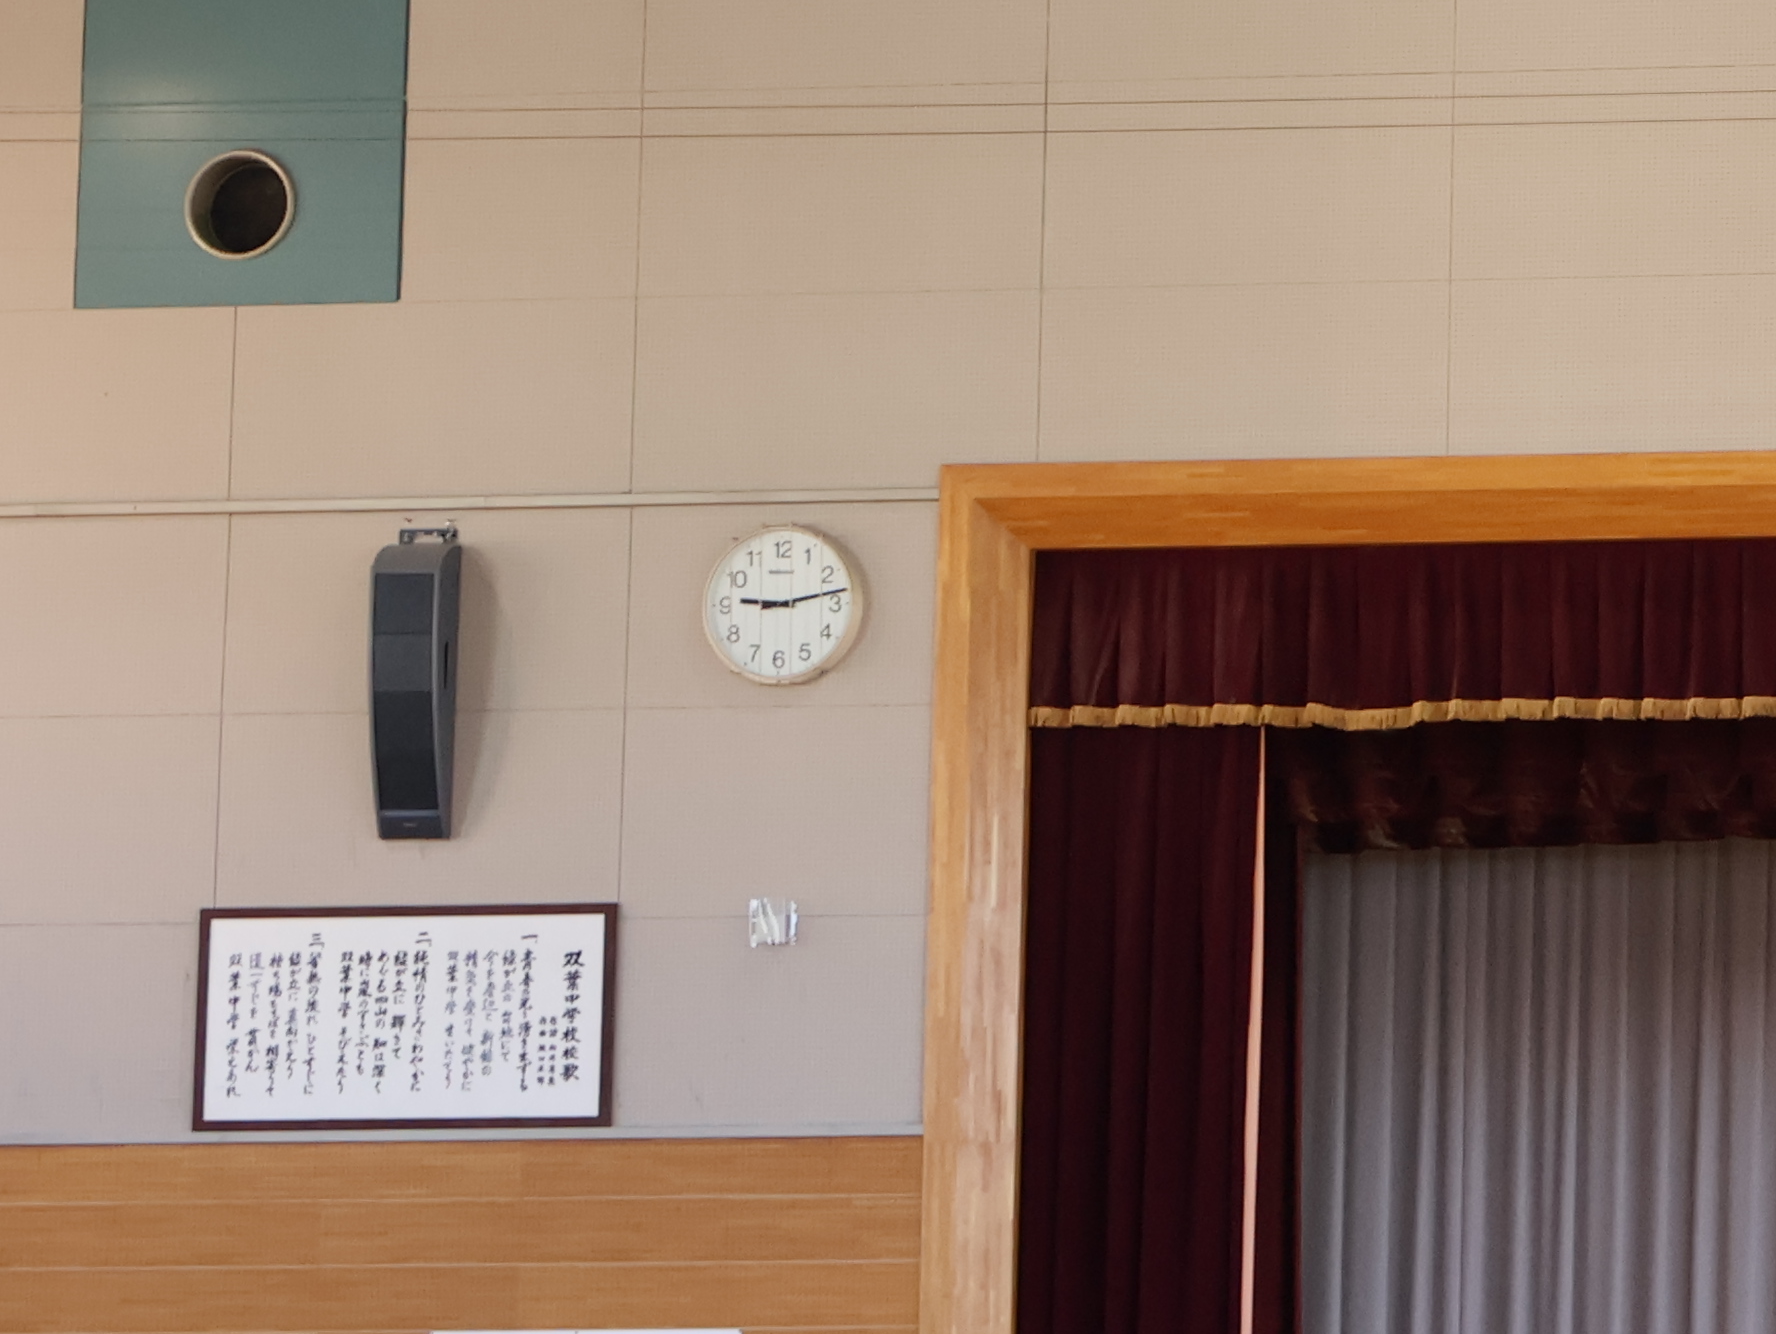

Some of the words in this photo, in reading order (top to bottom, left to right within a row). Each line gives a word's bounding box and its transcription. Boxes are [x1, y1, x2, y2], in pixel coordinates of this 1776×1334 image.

[747, 550, 763, 567] 11
[774, 540, 793, 559] 12
[804, 548, 812, 565] 1
[728, 569, 748, 589] 10
[821, 566, 835, 584] 2
[719, 596, 732, 615] 9
[828, 593, 842, 613] 3
[726, 624, 741, 644] 8
[820, 623, 832, 640] 4
[749, 644, 761, 663] 7
[772, 650, 786, 669] 6
[798, 643, 812, 661] 5
[560, 949, 585, 1083] 双葉中学校校歌
